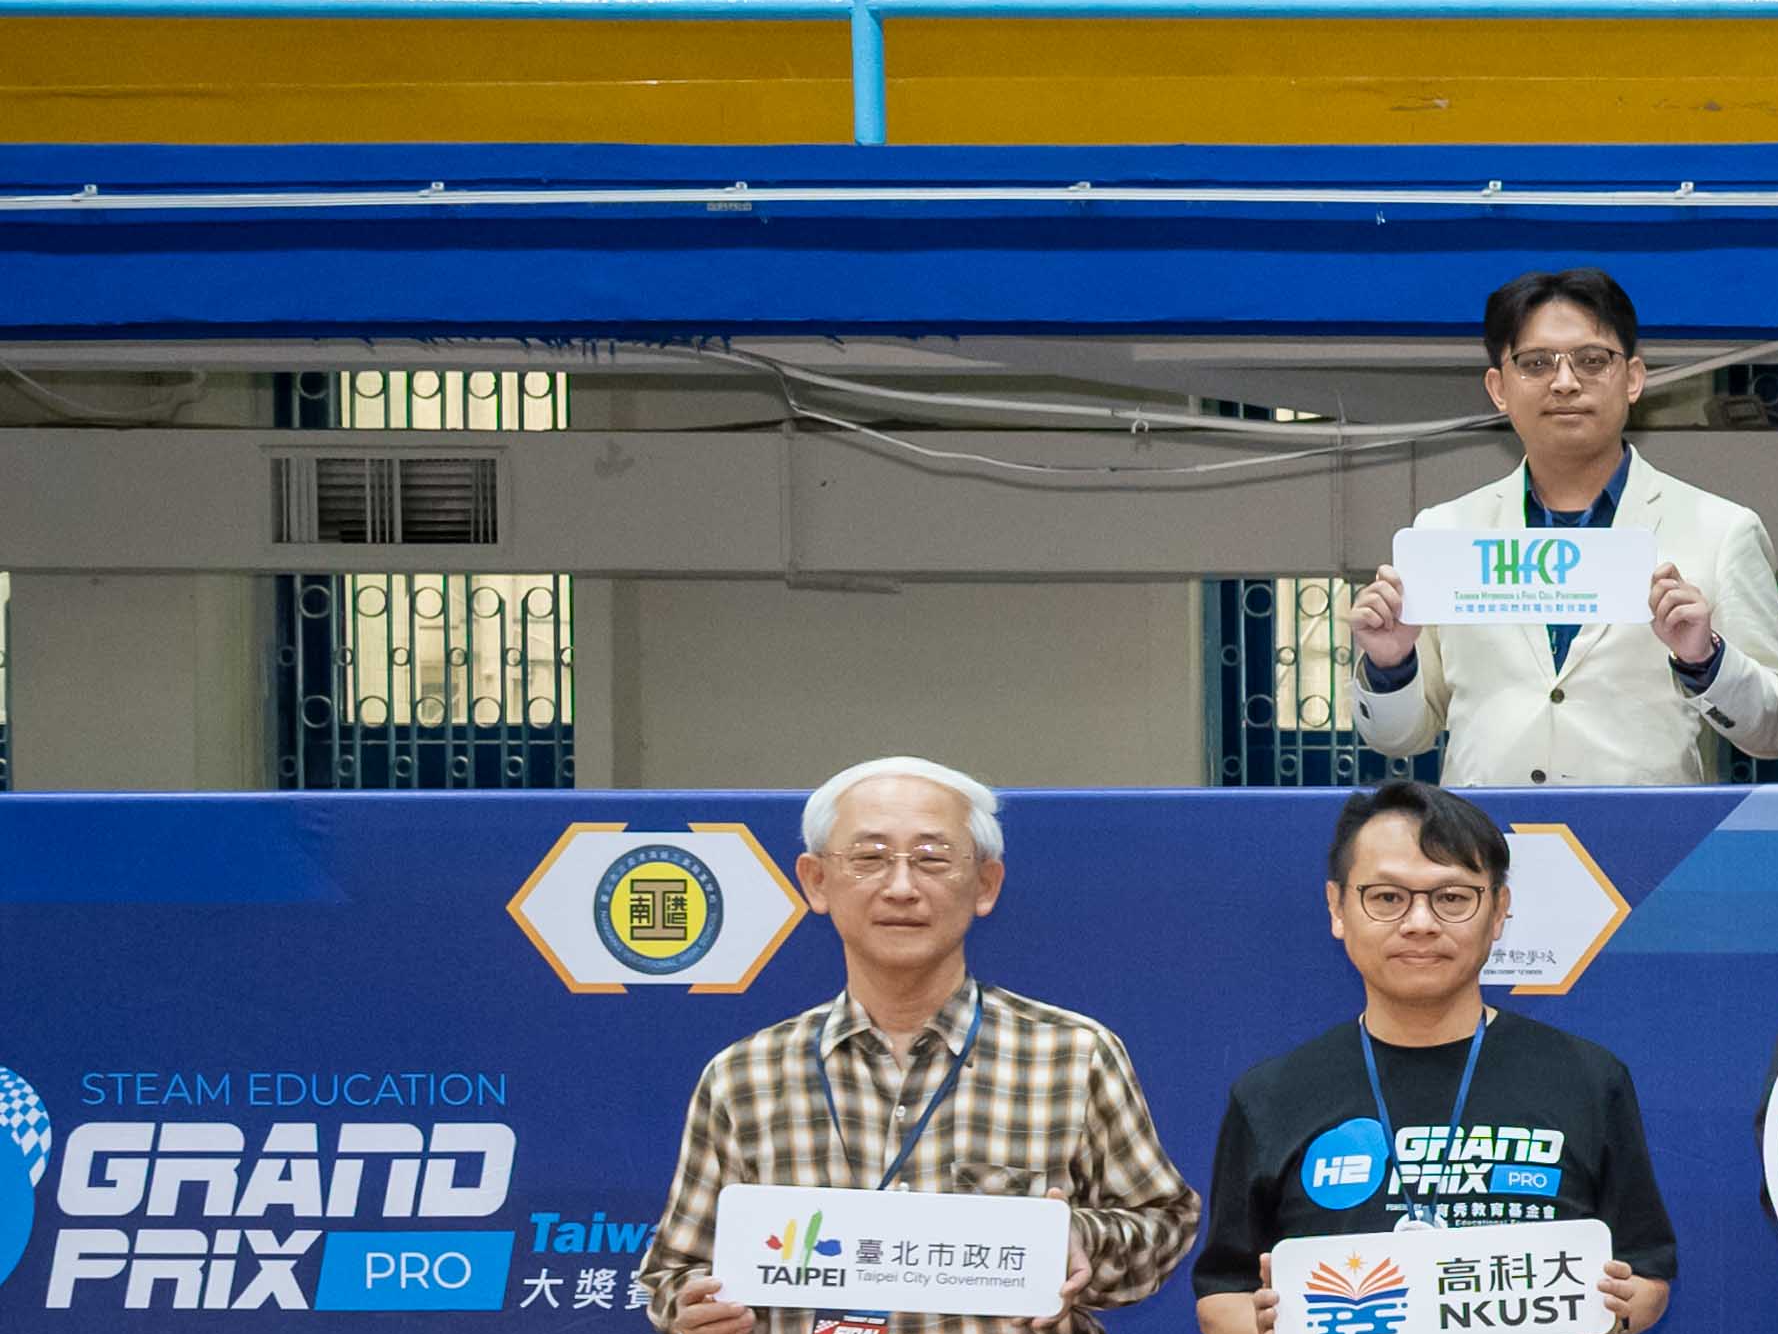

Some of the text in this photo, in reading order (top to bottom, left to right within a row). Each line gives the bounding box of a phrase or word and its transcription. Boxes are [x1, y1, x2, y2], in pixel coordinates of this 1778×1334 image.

[82, 1073, 507, 1107] STEAM EDUCATION
[1395, 1125, 1565, 1164] GRAND
[56, 1122, 517, 1218] GRAND
[1313, 1155, 1372, 1187] H2
[1508, 1171, 1548, 1188] PRO
[46, 1229, 326, 1310] PRIX
[364, 1252, 472, 1290] PRO
[855, 1238, 1027, 1272] 臺北市政府
[757, 1264, 846, 1288] TAIPEI
[856, 1269, 1026, 1289] Taipei City Government
[1437, 1250, 1584, 1296] 高科大
[1439, 1294, 1586, 1330] NKUST
